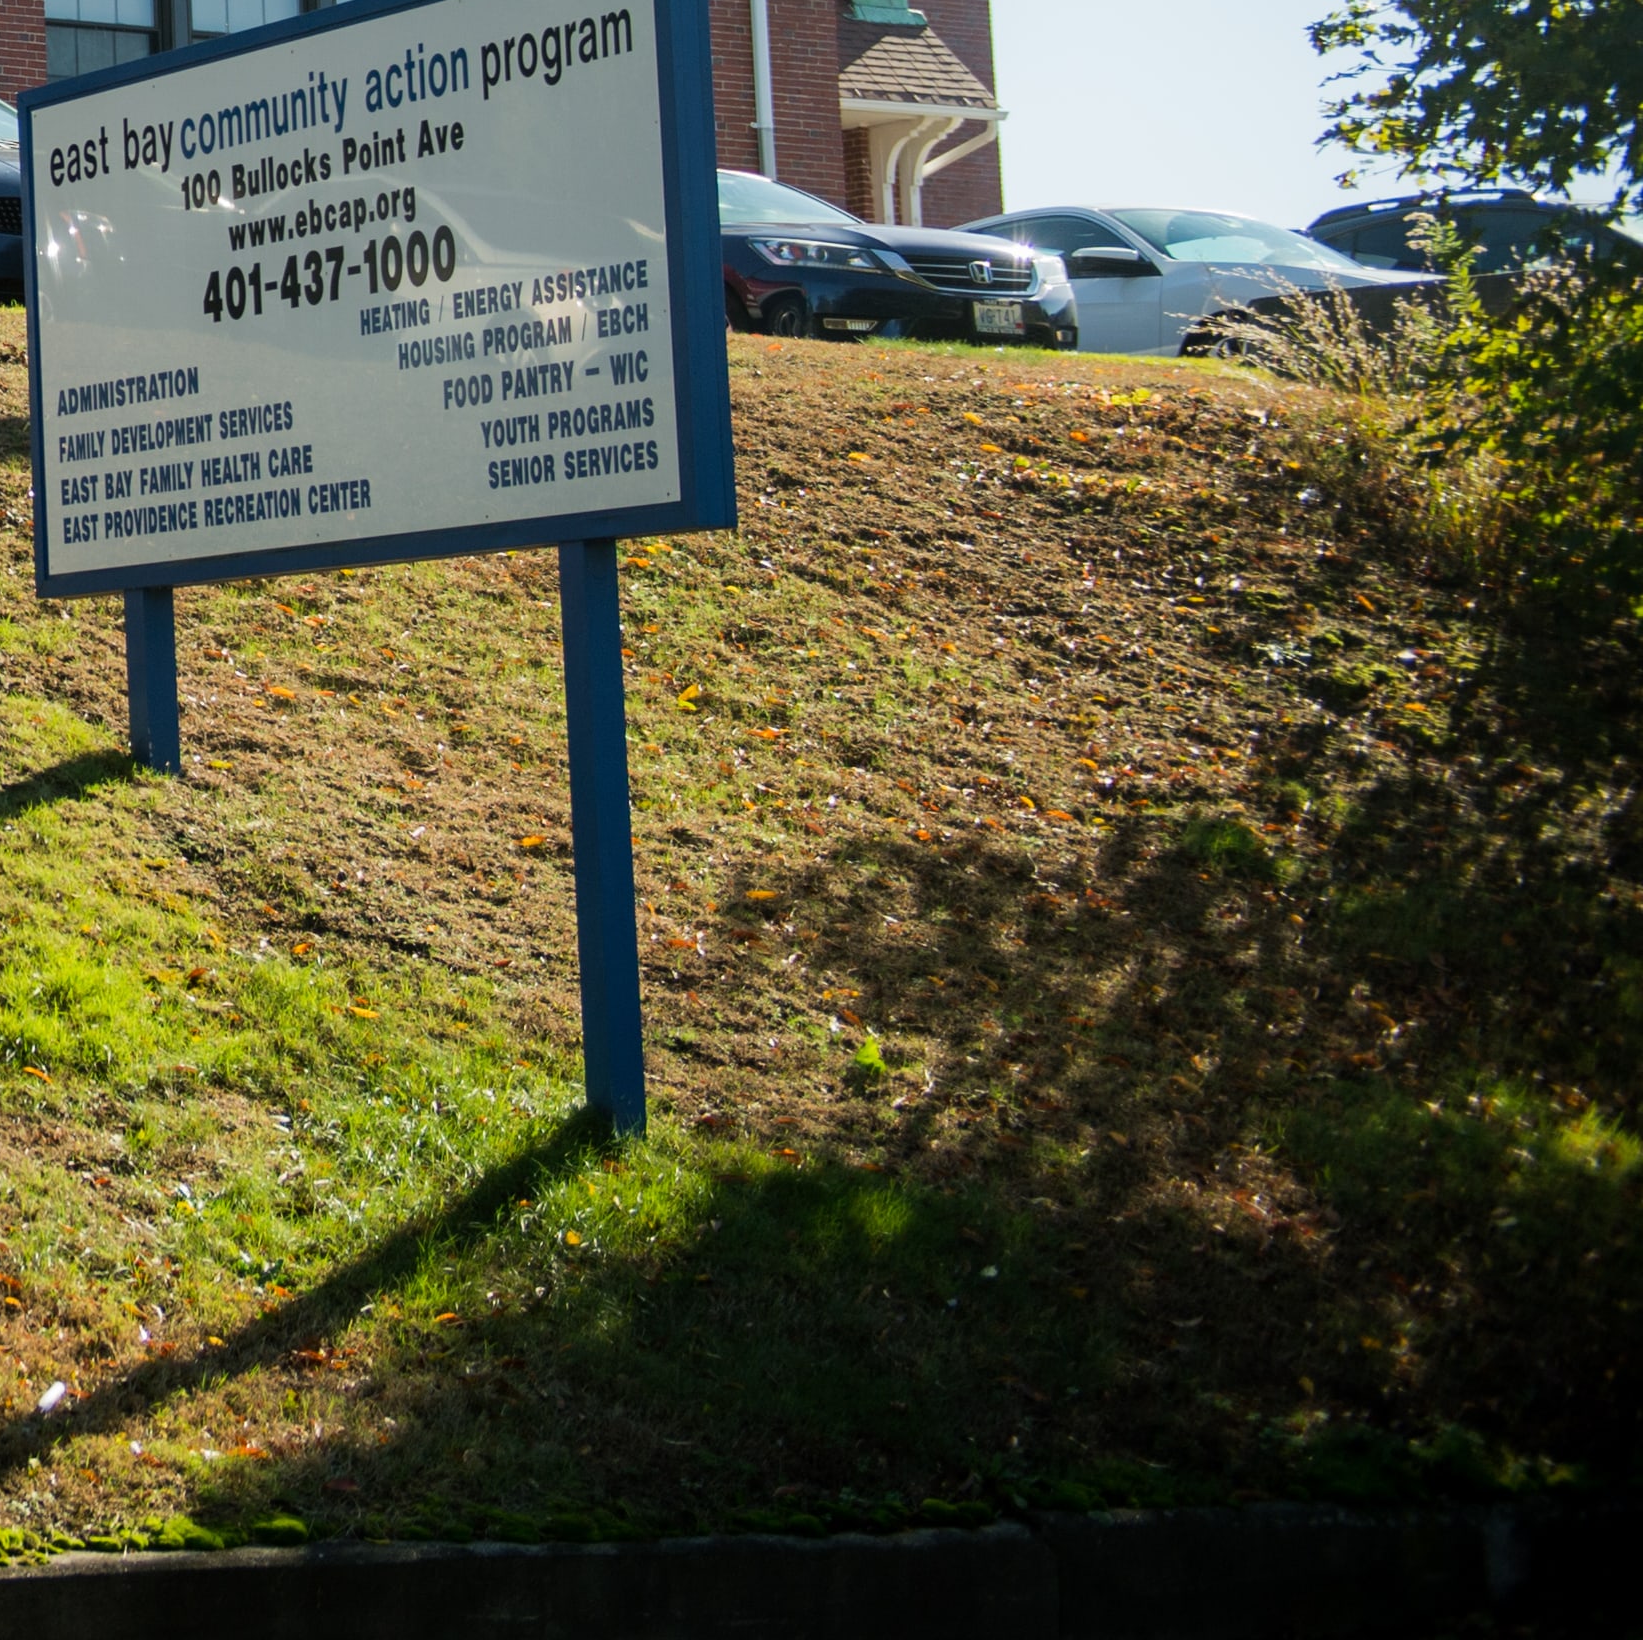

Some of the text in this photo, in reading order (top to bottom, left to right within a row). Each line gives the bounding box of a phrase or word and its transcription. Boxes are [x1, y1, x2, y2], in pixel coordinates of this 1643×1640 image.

[50, 8, 633, 187] east bay community action program
[181, 119, 464, 210] 100 Bullocks Point Ave
[229, 186, 416, 251] www.ebcap.org
[203, 225, 456, 323] 401-437-1000
[360, 297, 430, 336] HEATING
[453, 281, 523, 319] ENERGY
[532, 259, 648, 306] ASSISTANCE
[398, 331, 475, 370] HOUSING
[483, 315, 572, 356] PROGRAM
[597, 303, 649, 338] EBCH
[57, 366, 199, 417] ADMINISTRATION
[444, 374, 493, 410] FOOD
[502, 361, 574, 401] PANTRY
[610, 350, 648, 385] WIC
[59, 401, 293, 463] FAMILY DEVELOPMENT SERVICES
[481, 397, 654, 448] YOUTH PROGRAMS
[61, 444, 313, 506] EAST BAY FAMILY HEALTH CARE
[488, 440, 659, 489] SENIOR SERVICES
[64, 478, 371, 544] EAST PROVIDENCE RECREATION CENTER
